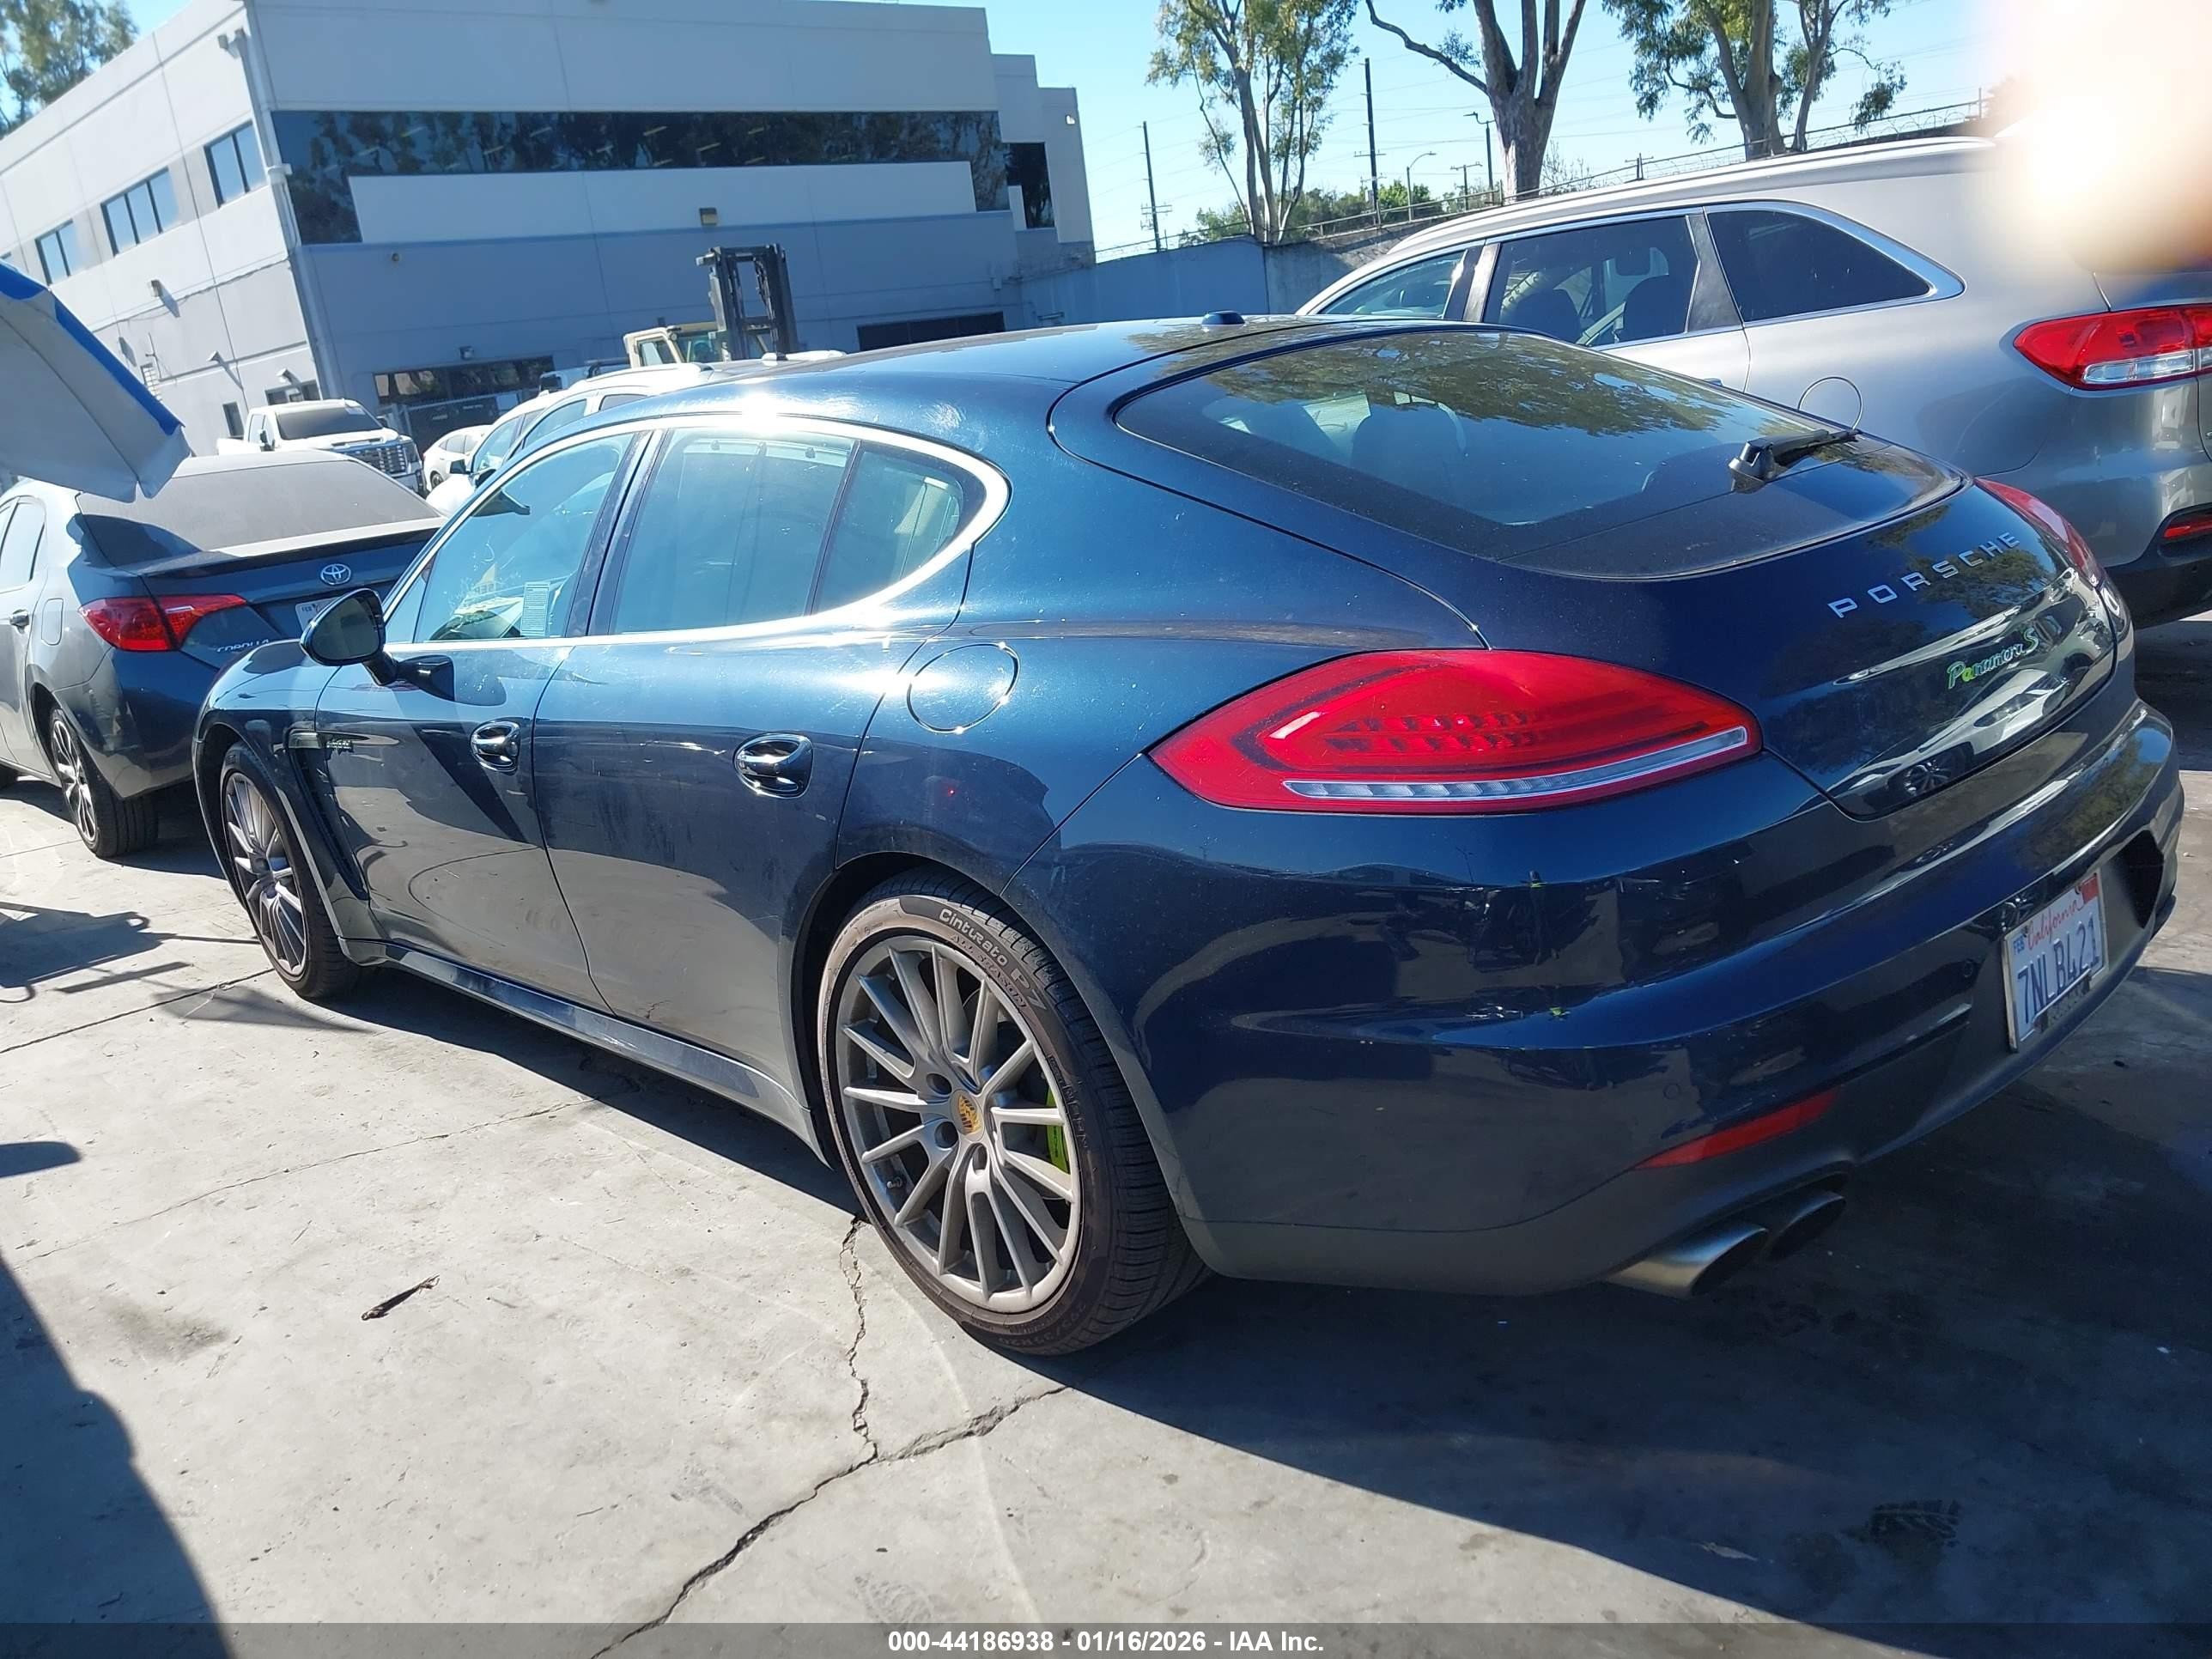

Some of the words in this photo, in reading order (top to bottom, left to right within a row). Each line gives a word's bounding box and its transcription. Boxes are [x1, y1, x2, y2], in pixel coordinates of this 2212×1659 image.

[1827, 532, 2021, 618] PORSCHE
[1947, 643, 2025, 689] Panamera
[2023, 627, 2039, 653] S
[939, 908, 1008, 967] Cinturato
[2027, 896, 2085, 951] California
[977, 953, 1028, 1010] SEASON
